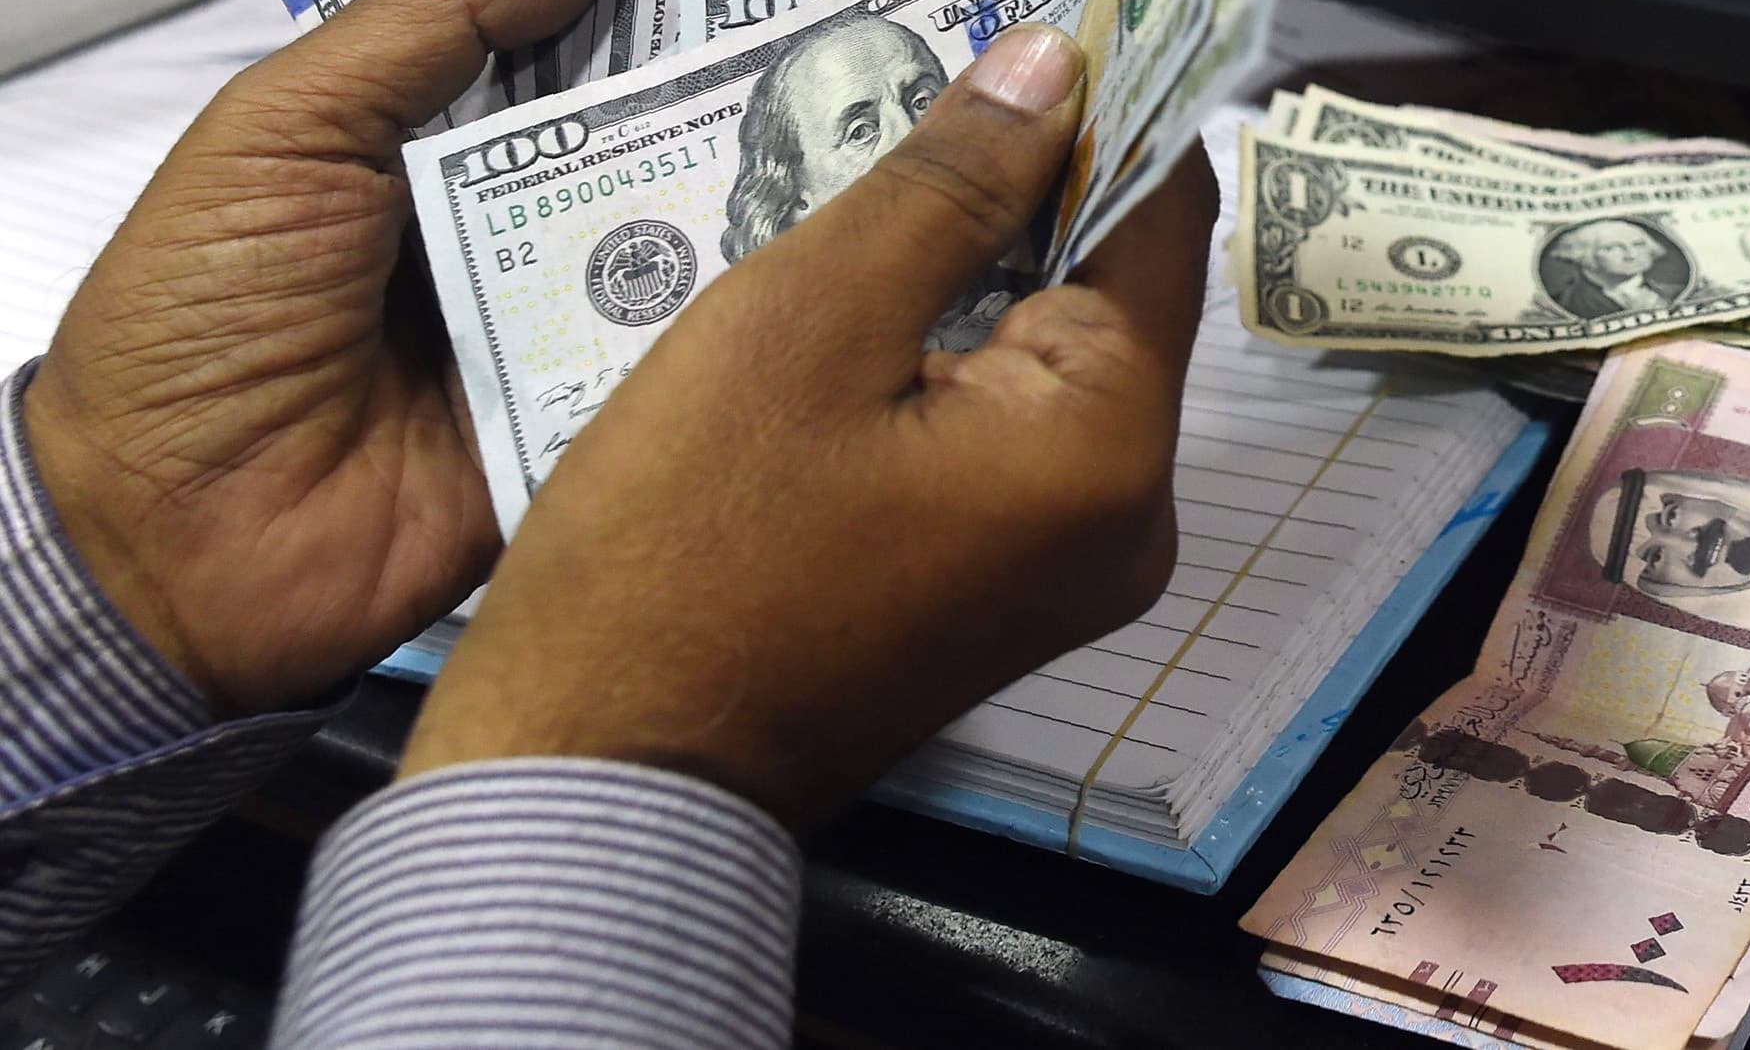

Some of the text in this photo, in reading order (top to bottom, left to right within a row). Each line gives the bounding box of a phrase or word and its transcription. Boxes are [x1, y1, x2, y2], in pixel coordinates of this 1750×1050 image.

[460, 119, 590, 188] 100
[477, 101, 744, 204] FEDERAL RESERVE NOTE
[495, 240, 538, 275] B2
[1489, 323, 1585, 340] ONE
